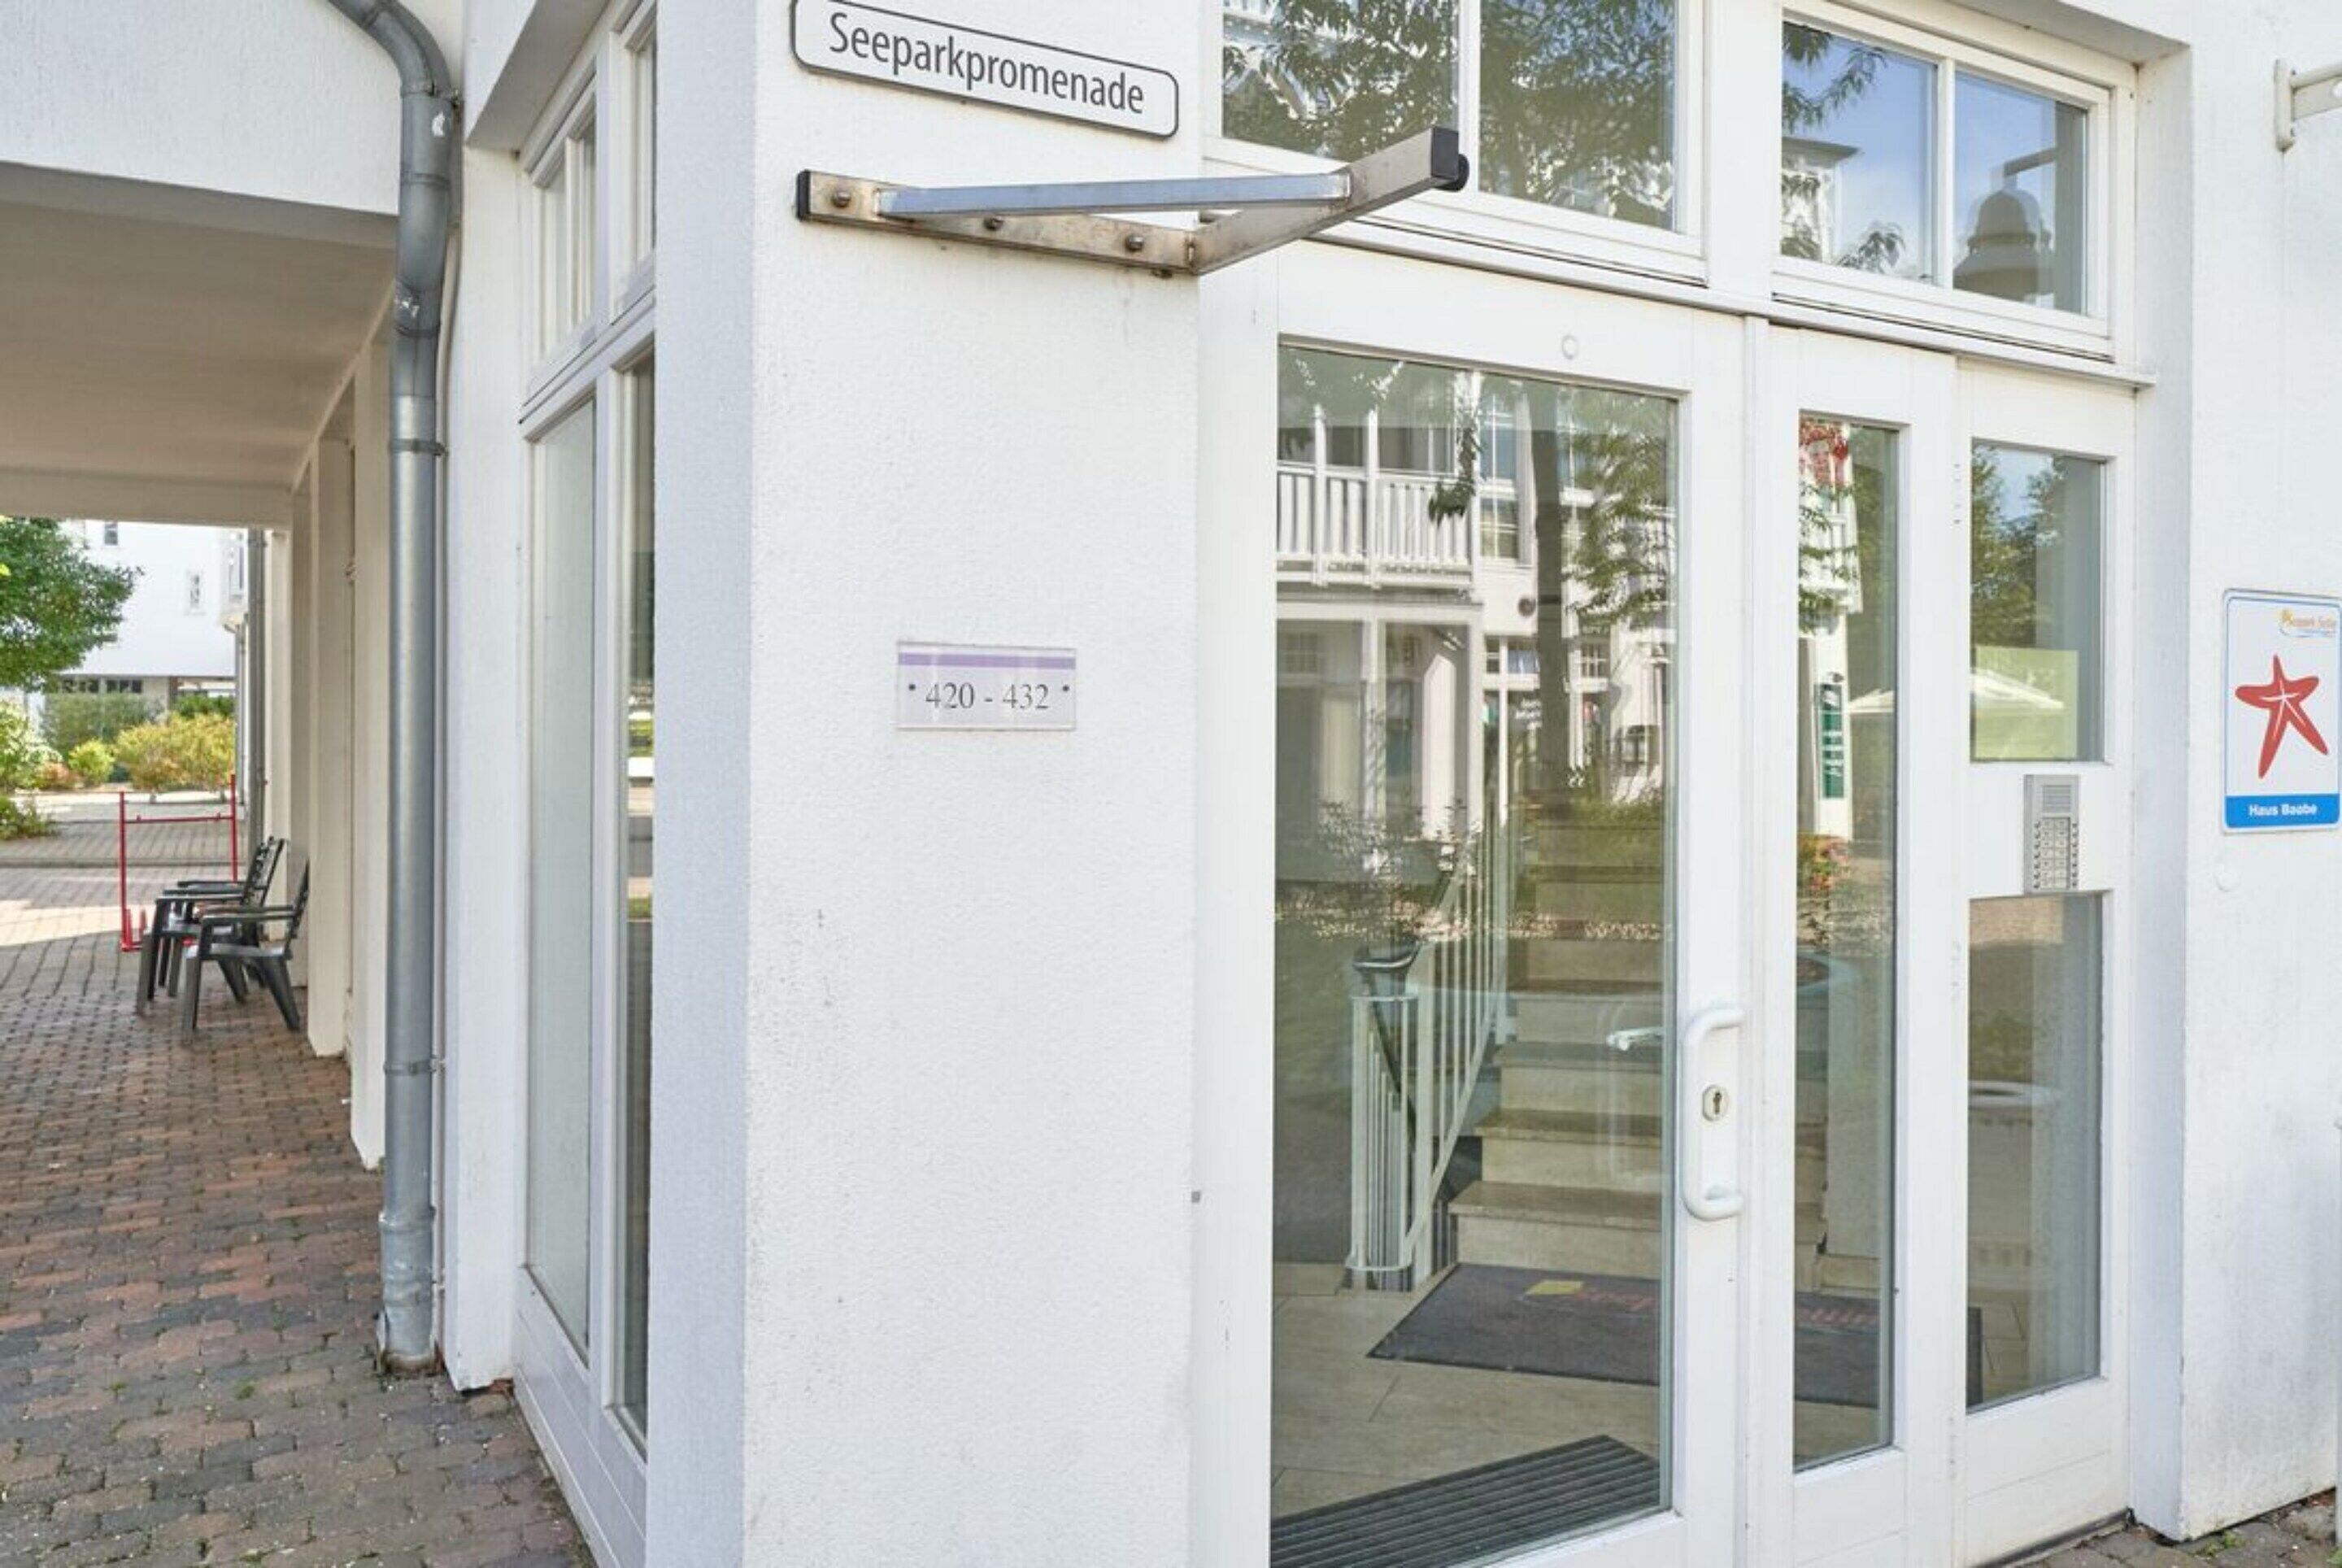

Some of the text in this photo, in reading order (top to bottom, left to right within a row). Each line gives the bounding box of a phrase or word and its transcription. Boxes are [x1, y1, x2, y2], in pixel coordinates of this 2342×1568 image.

[829, 11, 1144, 114] Seeparkpromenade
[925, 682, 975, 709] 420
[1002, 683, 1050, 710] 432
[2248, 804, 2279, 817] Haus
